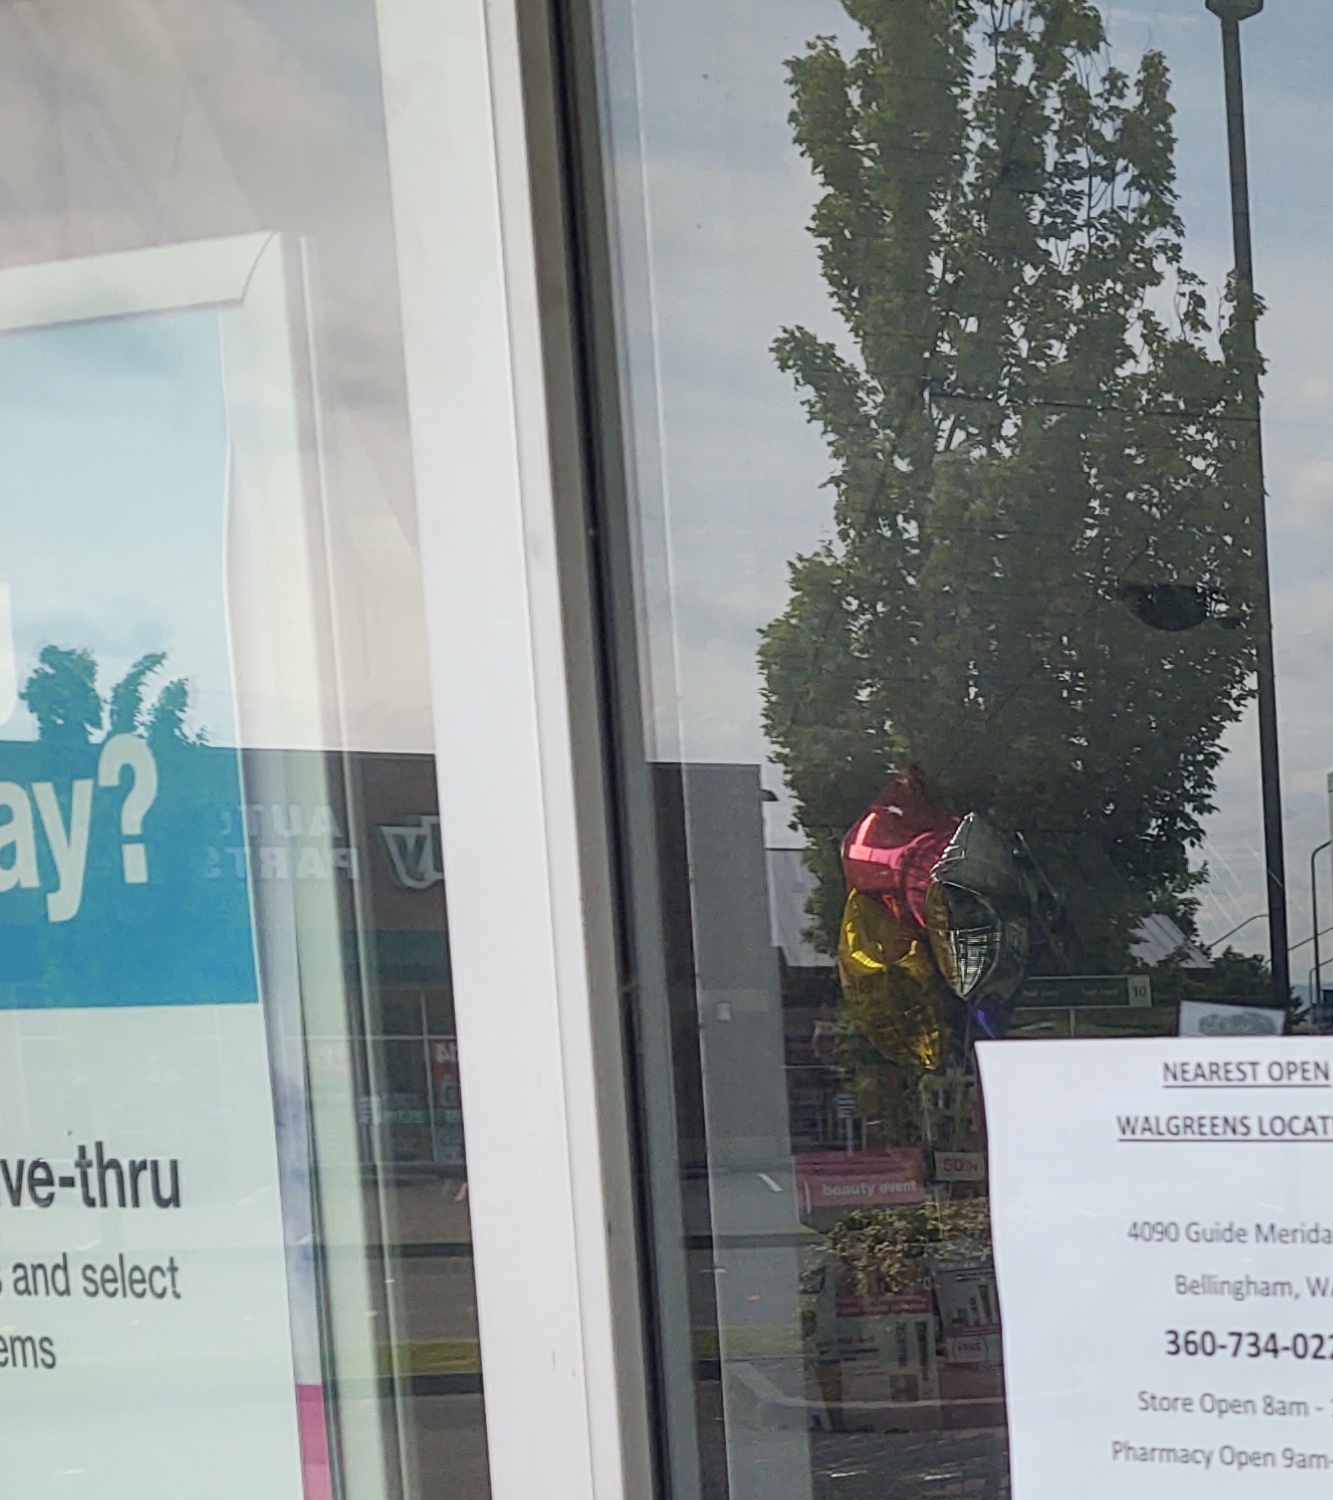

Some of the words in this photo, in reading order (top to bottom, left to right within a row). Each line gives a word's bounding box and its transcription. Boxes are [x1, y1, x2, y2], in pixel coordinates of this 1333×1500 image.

[1163, 1062, 1259, 1082] NEAREST
[1268, 1062, 1330, 1081] OPEN
[1117, 1116, 1250, 1137] WALGREENS
[822, 1179, 875, 1198] beauty
[879, 1178, 917, 1194] event
[1127, 1222, 1180, 1243] 4090
[1185, 1222, 1247, 1244] Guide
[13, 1253, 70, 1298] and
[82, 1254, 181, 1299] select
[1175, 1275, 1301, 1300] Bellingham,
[1137, 1392, 1195, 1413] Store
[1199, 1394, 1257, 1418] Open
[1261, 1396, 1309, 1417] 8am
[1111, 1441, 1213, 1469] Pharmacy
[1219, 1446, 1277, 1469] Open
